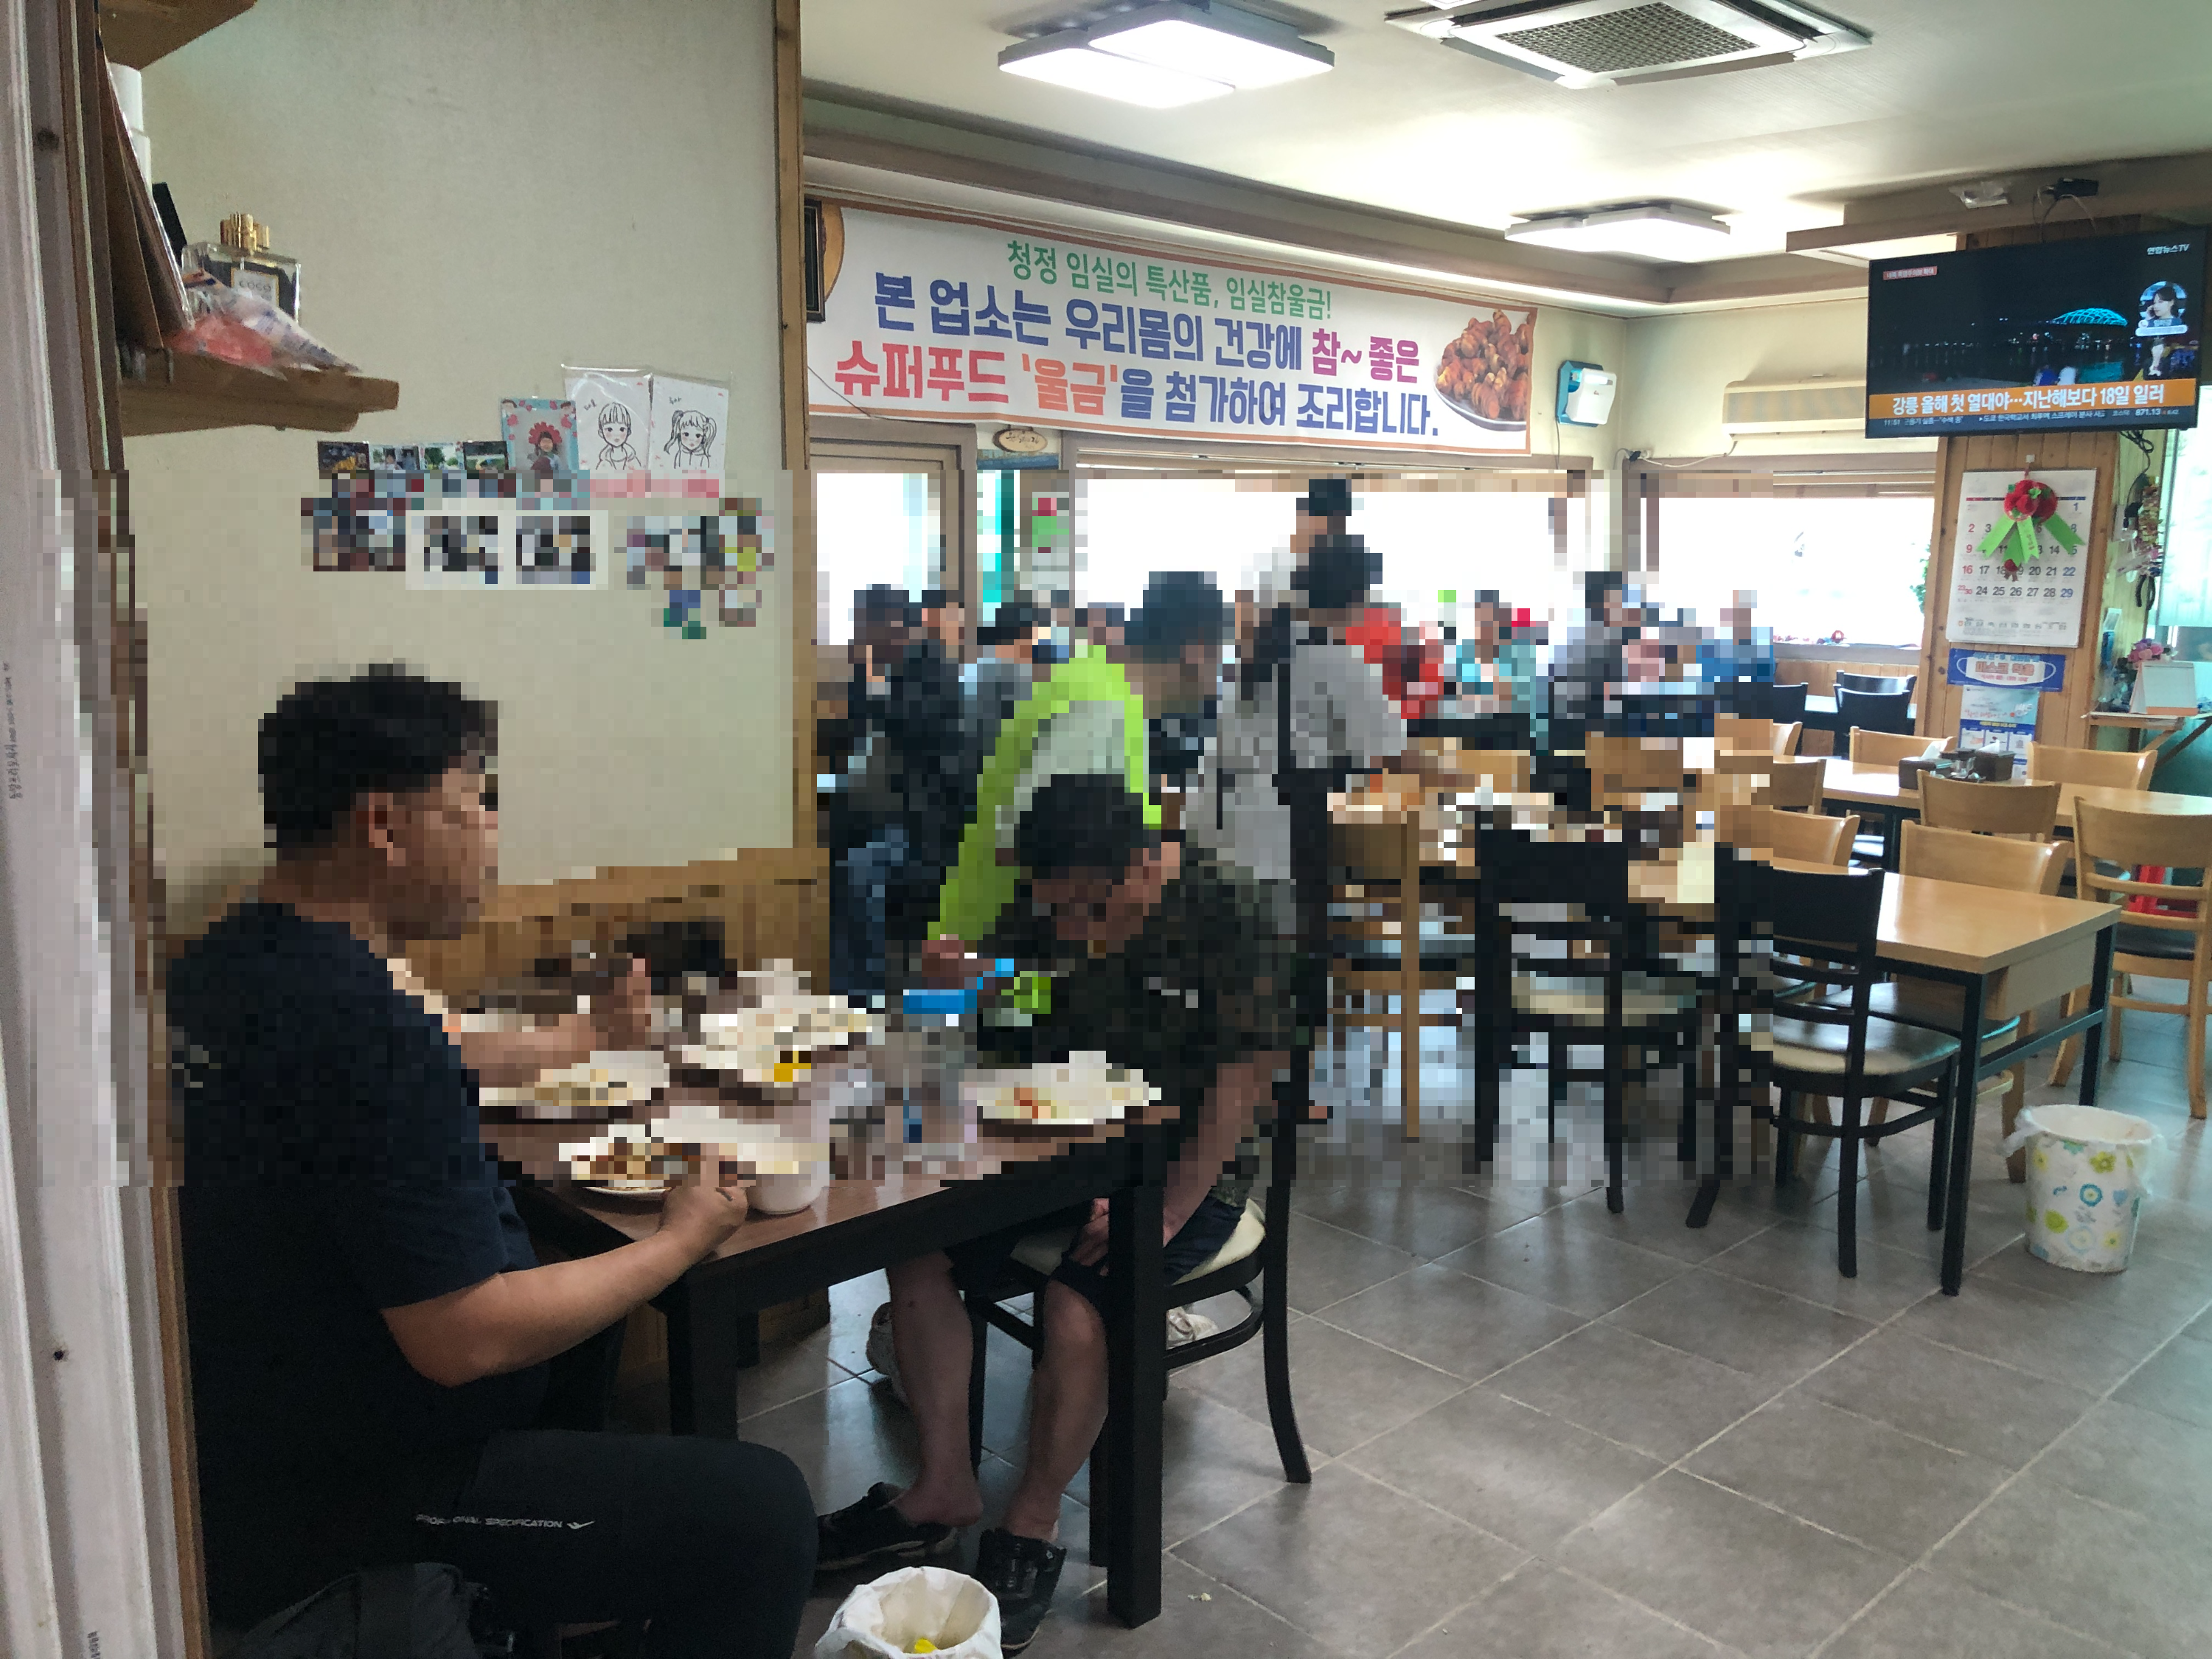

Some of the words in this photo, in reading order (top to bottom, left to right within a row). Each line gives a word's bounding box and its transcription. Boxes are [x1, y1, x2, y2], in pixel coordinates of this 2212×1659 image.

[1007, 240, 1057, 285] 청정
[1066, 251, 1138, 297] 임실의
[1145, 265, 1219, 309] 특산품,
[1226, 276, 1332, 321] 임실참울금!
[874, 271, 916, 332] 본
[929, 279, 1051, 347] 업소는
[1065, 298, 1204, 363] 우리몸의
[1214, 317, 1302, 371] 건강에
[1312, 327, 1363, 377] 참~
[1368, 335, 1419, 383] 좋은
[835, 340, 1009, 404] 슈퍼푸드
[1021, 353, 1155, 420] '울금'을
[1165, 370, 1285, 426] 첨가하여
[1295, 381, 1439, 437] 조리합니다.
[1893, 397, 1919, 415] 강릉
[1921, 394, 1949, 414] 올해
[1951, 394, 1964, 413] 첫
[2100, 386, 2130, 406] 18일
[2133, 383, 2165, 405] 일러
[2135, 408, 2161, 417] 871.13
[2073, 502, 2079, 512] 1
[1968, 523, 1975, 532] 2
[1985, 524, 1992, 533] 3
[1966, 544, 1972, 553] 9
[2049, 545, 2060, 554] 14
[1962, 565, 1973, 574] 16
[1979, 565, 1990, 574] 17
[2028, 566, 2042, 576] 20
[2045, 566, 2057, 576] 21
[2062, 566, 2076, 577] 22
[1975, 585, 1988, 595] 24
[1992, 586, 2006, 596] 25
[2009, 587, 2023, 597] 26
[2026, 587, 2039, 597] 27
[2043, 588, 2056, 597] 28
[2060, 588, 2073, 598] 29
[1975, 661, 2009, 674] 마스크
[484, 1517, 563, 1528] SPECIFICATION
